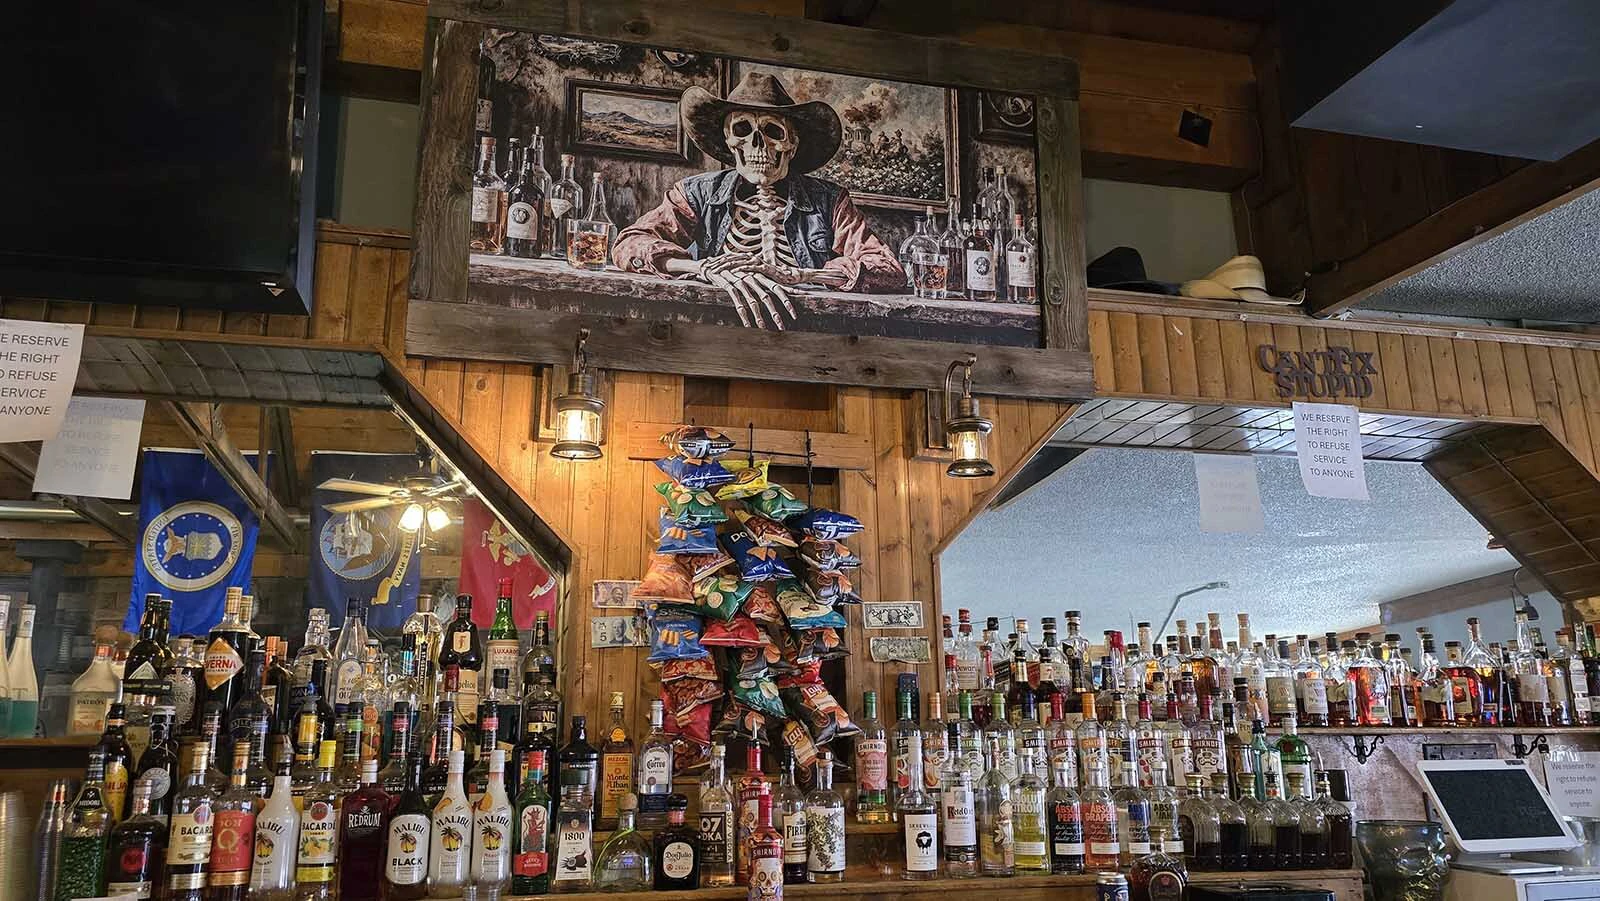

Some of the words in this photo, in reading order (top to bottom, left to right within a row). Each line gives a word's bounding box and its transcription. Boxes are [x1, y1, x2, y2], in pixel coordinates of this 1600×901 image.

[0, 333, 9, 344] E
[12, 334, 69, 347] RESERVE
[20, 353, 60, 364] RIGHT
[8, 370, 57, 382] REFUSE
[1275, 371, 1374, 398] STUPID
[0, 387, 48, 399] ERVICE
[0, 405, 52, 416] ANYONE
[1301, 413, 1314, 421] WE
[1316, 414, 1351, 423] RESERVE
[1305, 427, 1322, 435] THE
[1324, 427, 1348, 437] RIGHT
[1307, 441, 1318, 449] TO
[1320, 441, 1350, 451] REFUSE
[1313, 455, 1347, 464] SERVICE
[1310, 468, 1321, 476] TO
[1322, 468, 1355, 478] ANYONE
[600, 632, 607, 641] 5
[348, 813, 381, 828] REDRUM
[436, 815, 470, 828] MALIBU
[477, 815, 510, 827] MALIBU
[256, 821, 286, 835] ALIBU
[565, 832, 585, 841] 1800
[392, 858, 423, 866] BLACK
